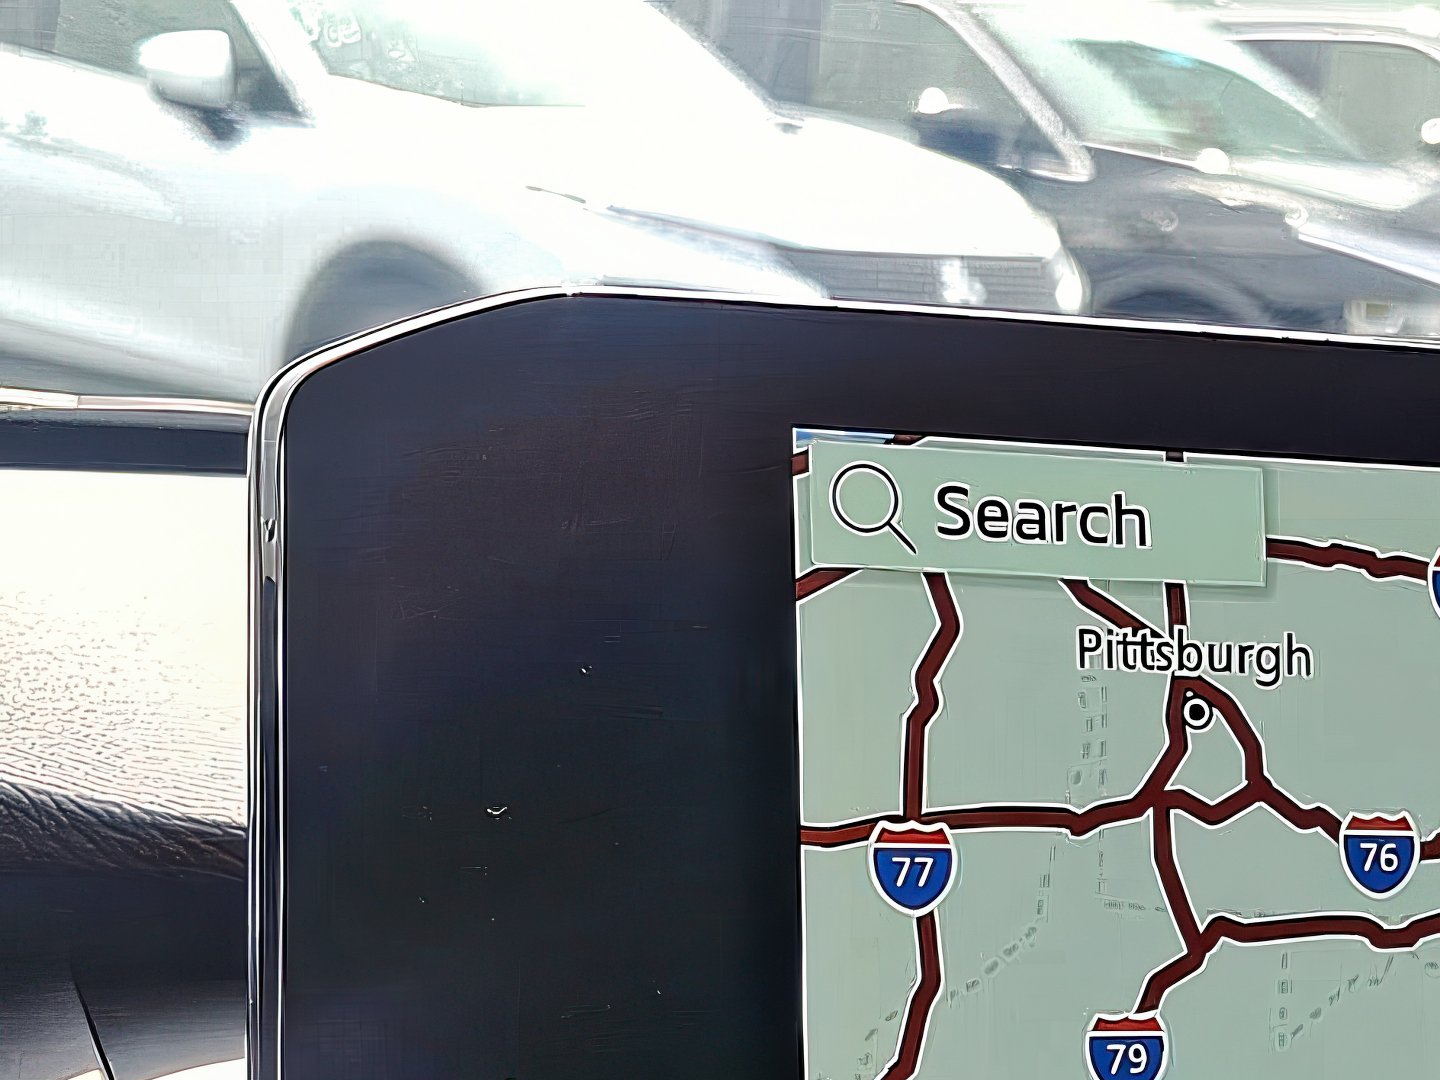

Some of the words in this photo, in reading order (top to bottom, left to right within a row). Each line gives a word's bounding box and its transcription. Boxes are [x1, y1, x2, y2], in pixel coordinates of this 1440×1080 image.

[935, 483, 1153, 549] Search
[1077, 627, 1313, 687] Pittsburgh
[890, 856, 934, 889] 77
[1359, 841, 1400, 872] 76
[1105, 1041, 1148, 1076] 79
